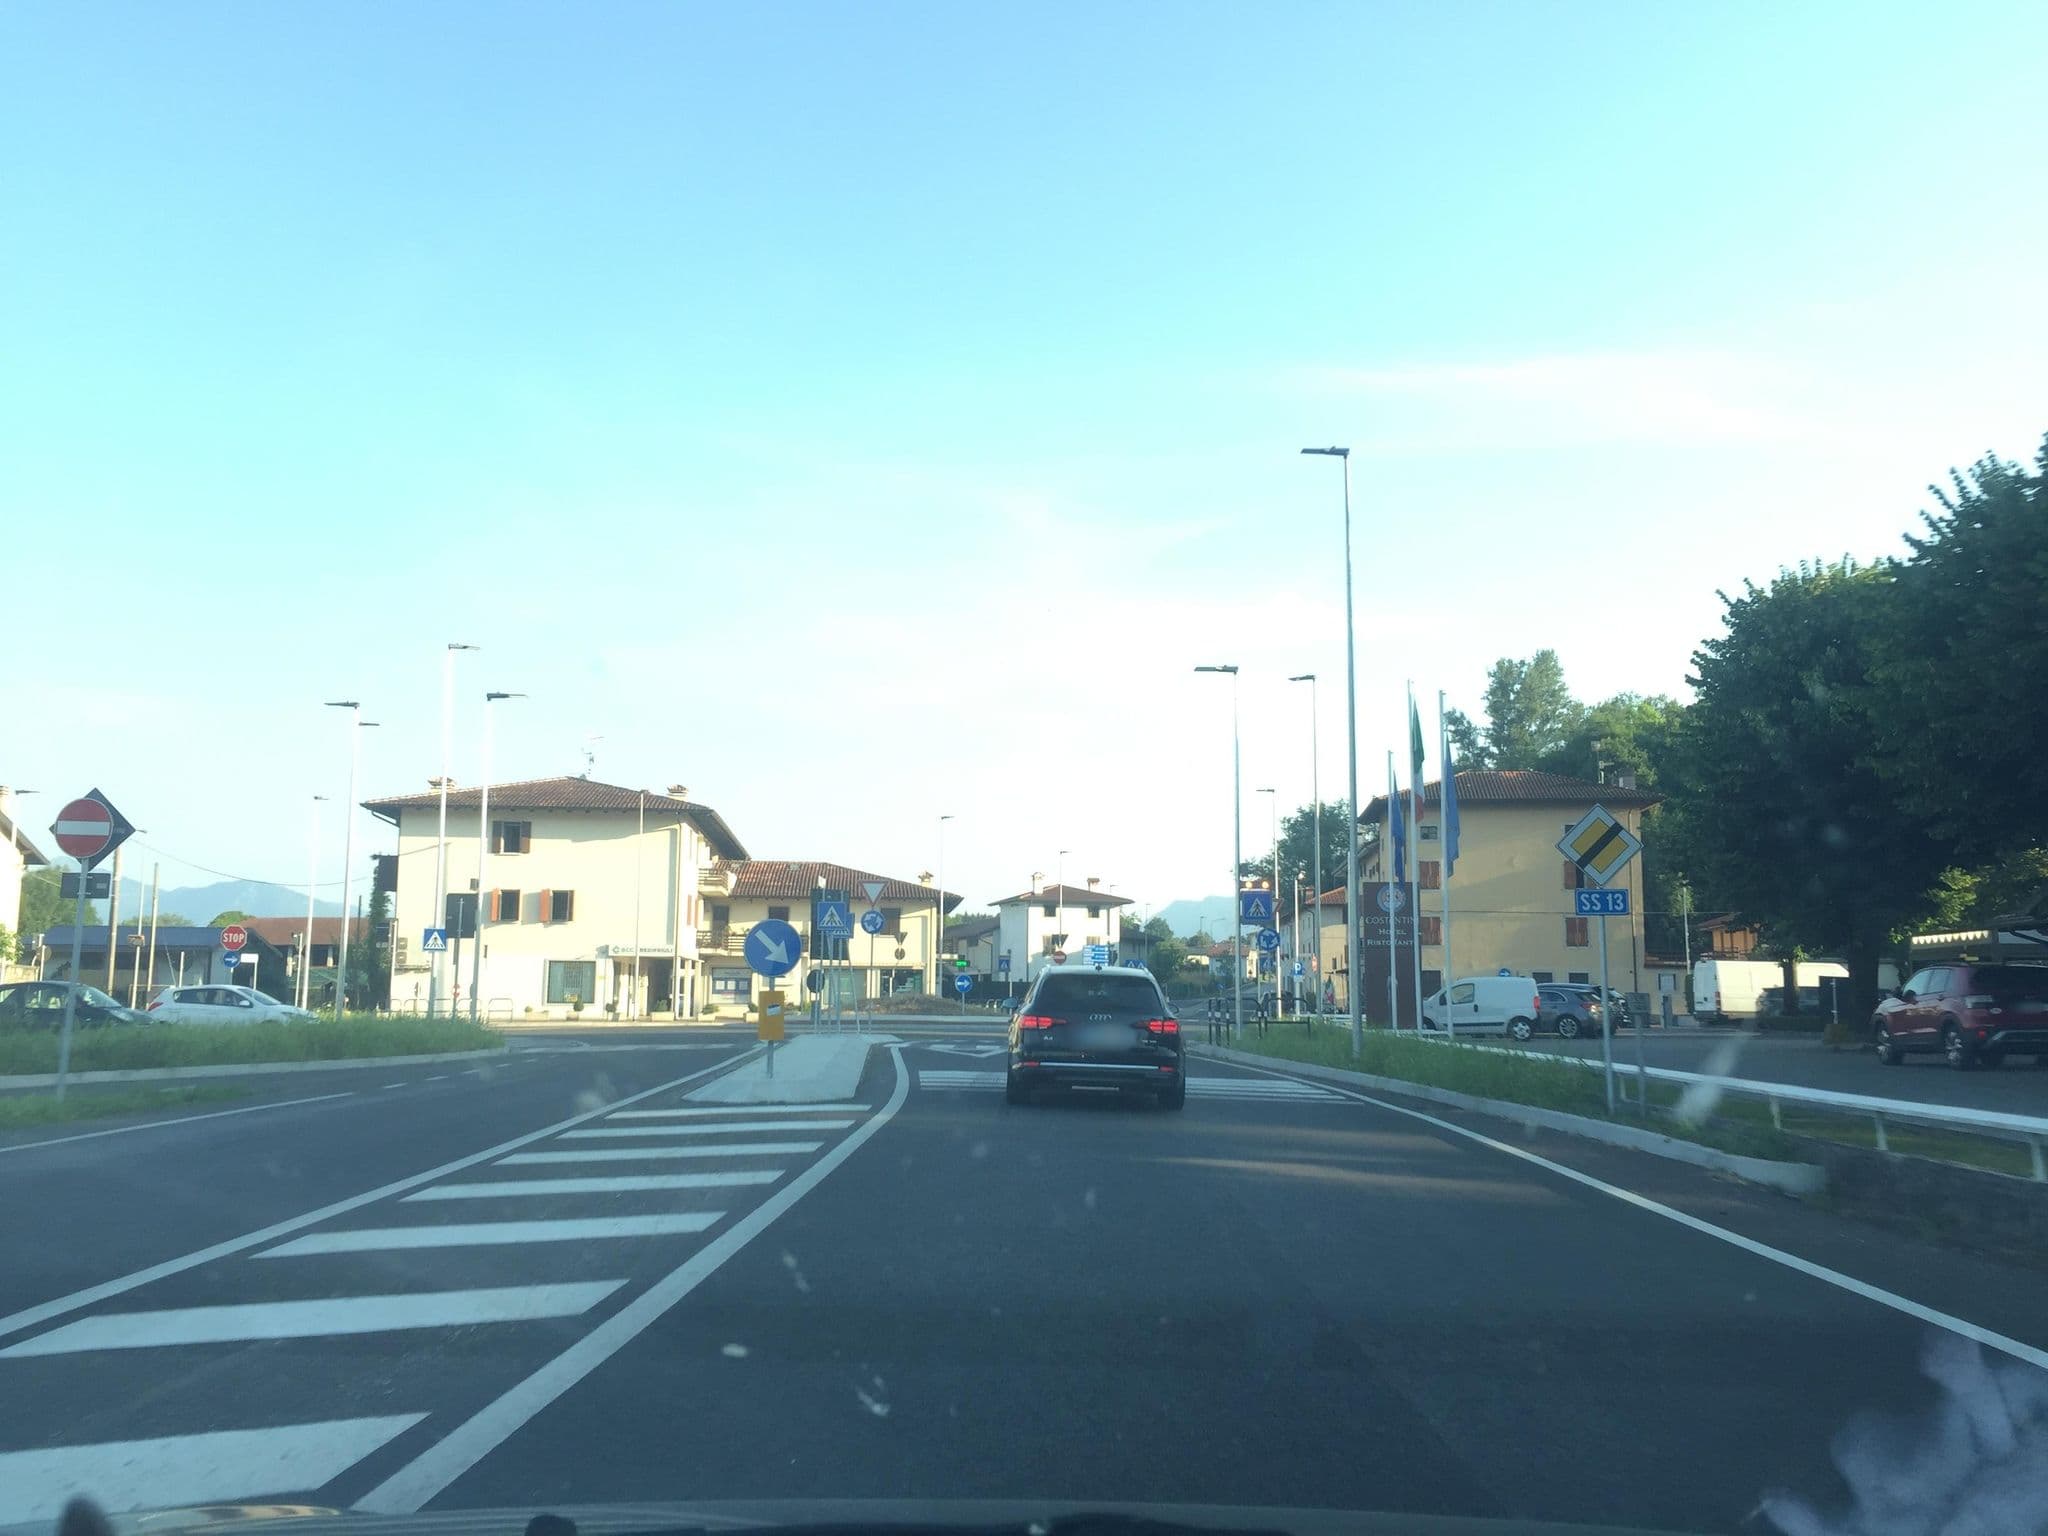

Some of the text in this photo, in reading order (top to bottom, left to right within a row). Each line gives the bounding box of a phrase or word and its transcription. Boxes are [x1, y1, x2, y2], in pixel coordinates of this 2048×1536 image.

[1580, 893, 1624, 911] SS 13
[223, 933, 244, 943] STOP
[1295, 962, 1302, 975] P
